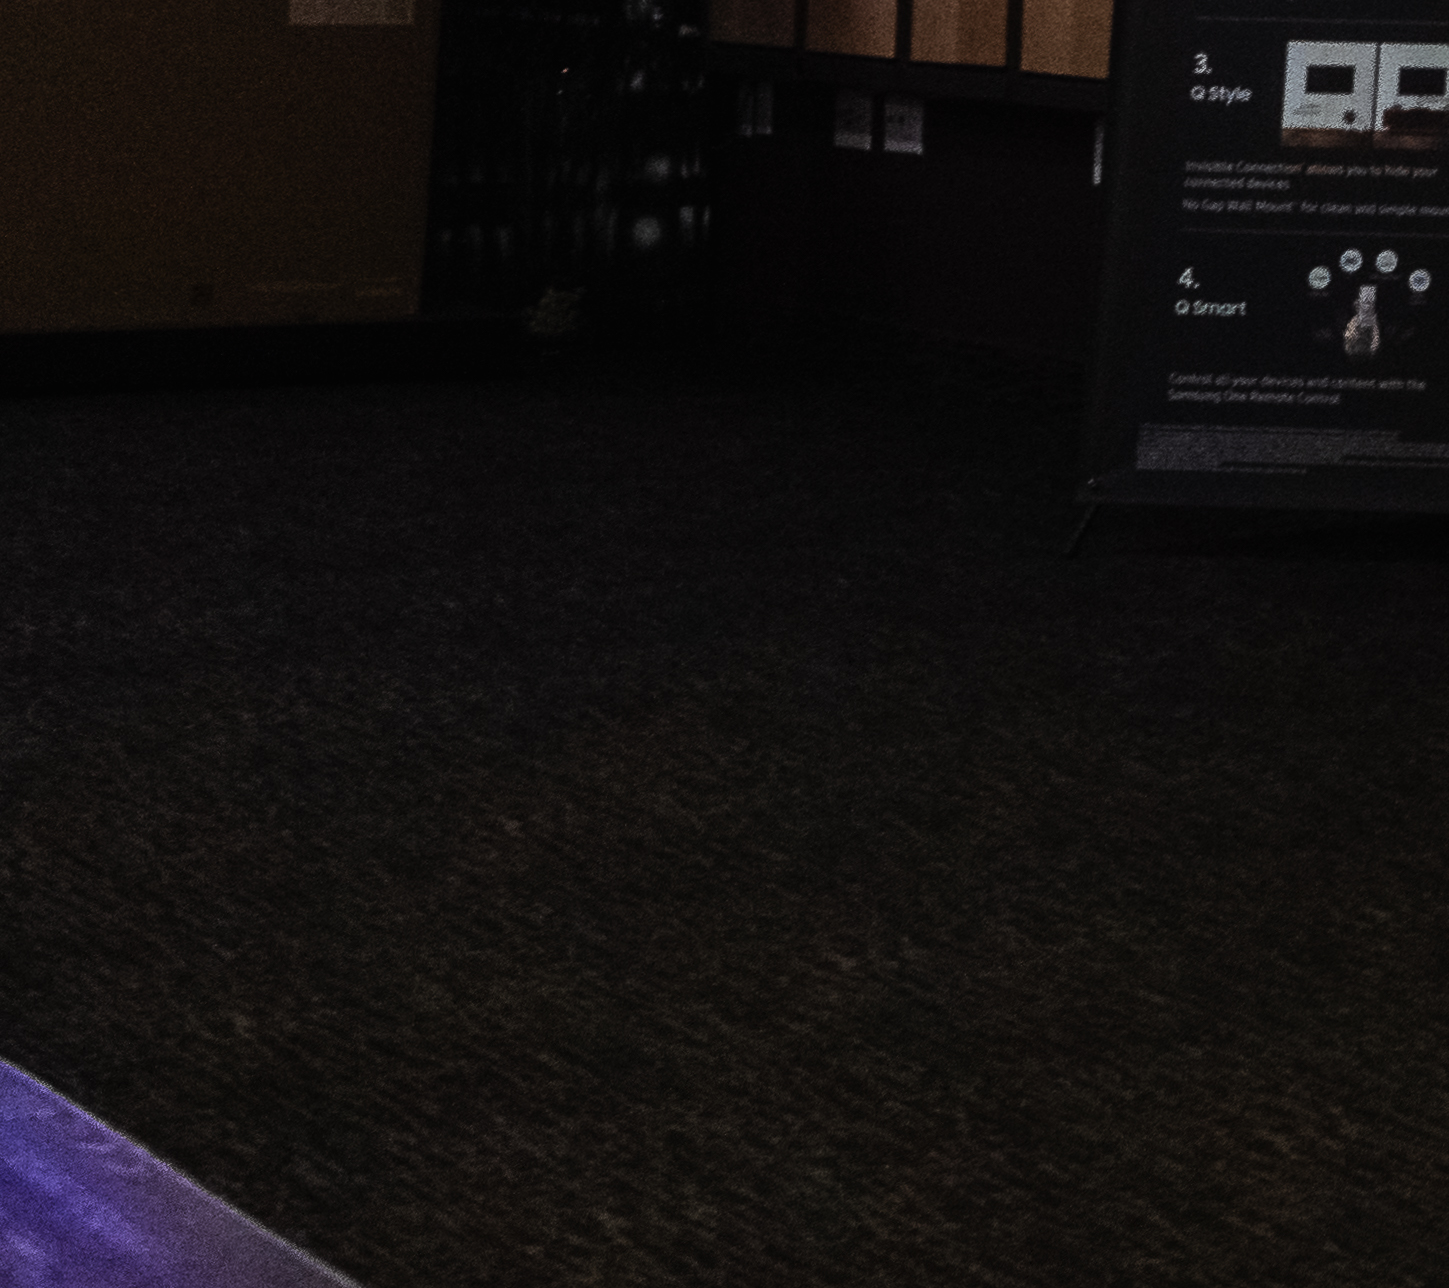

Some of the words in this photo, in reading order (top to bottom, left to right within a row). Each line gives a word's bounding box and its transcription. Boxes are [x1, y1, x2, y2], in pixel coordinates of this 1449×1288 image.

[1193, 52, 1212, 75] 3.
[1207, 86, 1252, 107] Style
[1177, 266, 1200, 290] 4.
[1192, 300, 1247, 317] Smart
